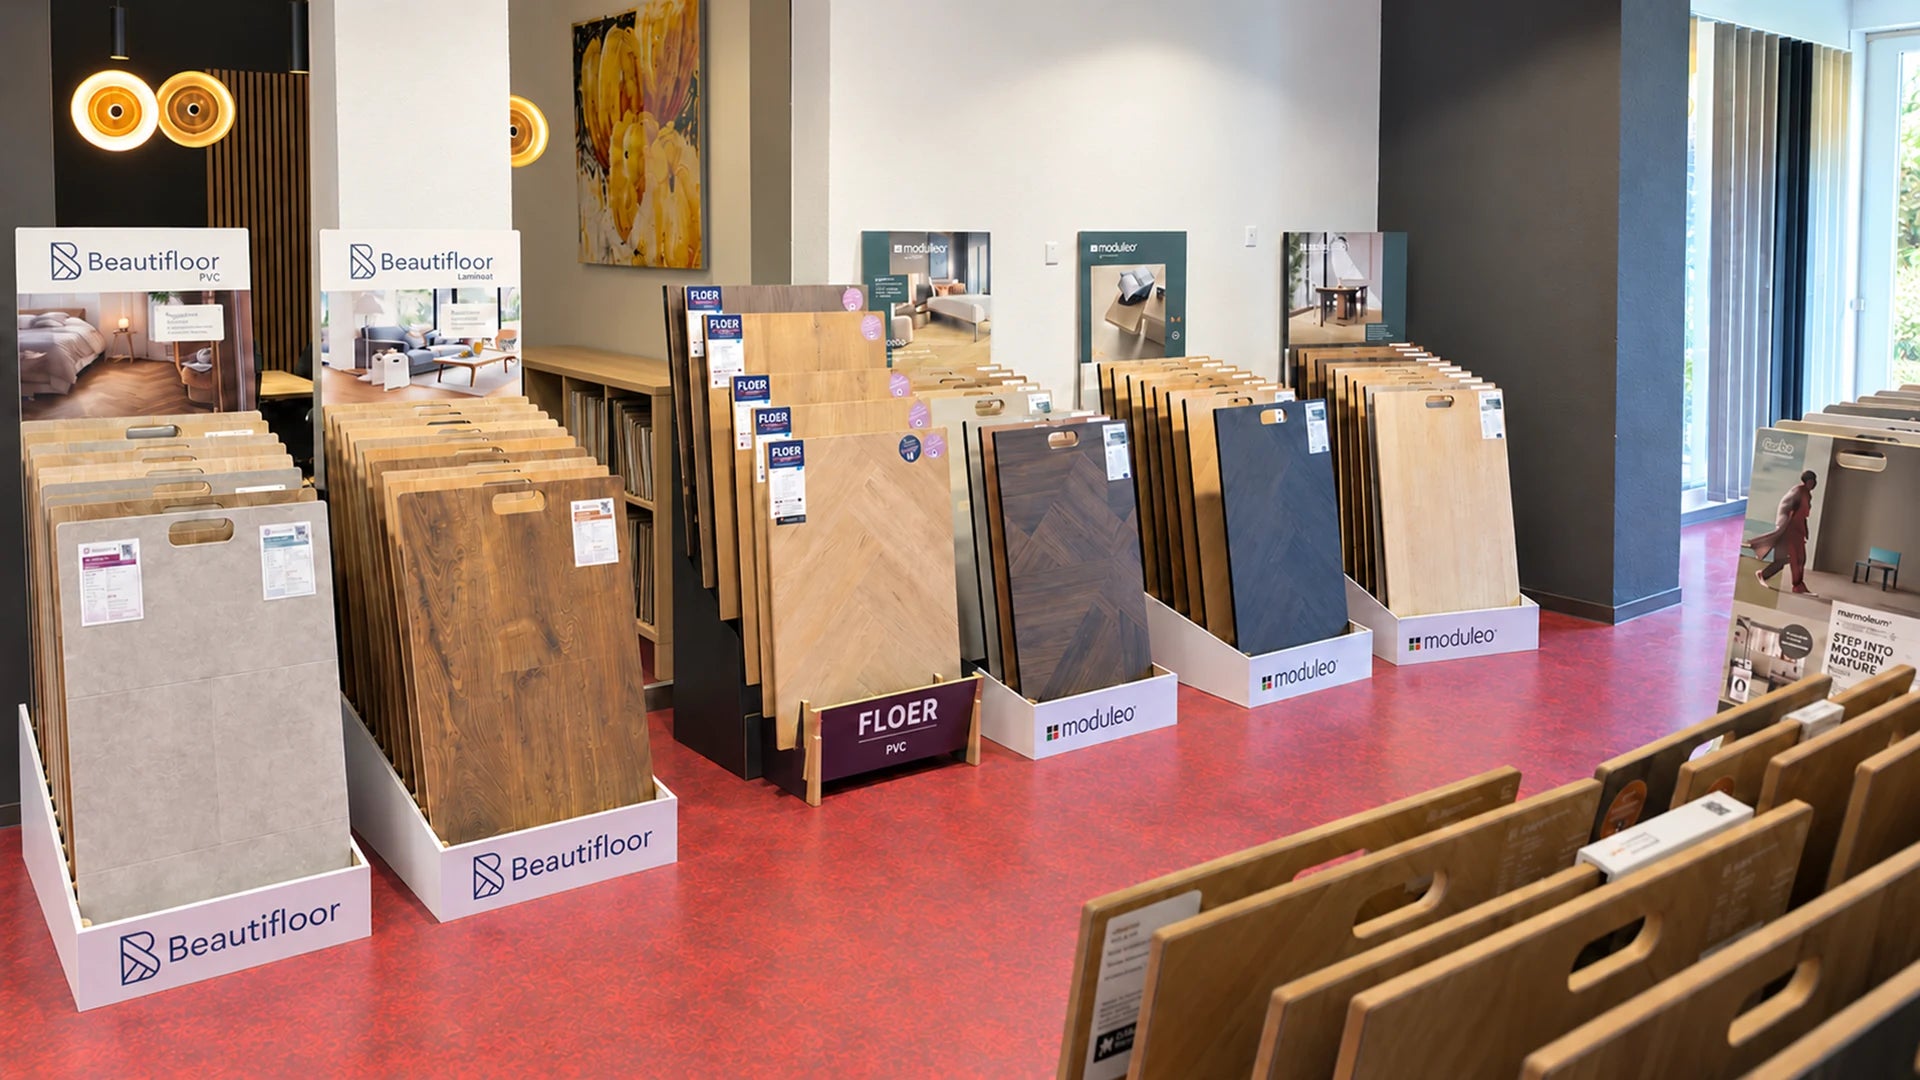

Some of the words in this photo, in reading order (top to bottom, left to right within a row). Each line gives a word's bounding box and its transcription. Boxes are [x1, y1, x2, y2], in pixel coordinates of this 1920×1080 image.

[88, 250, 220, 271] Beautifloor
[381, 251, 494, 271] Beautifloor
[199, 273, 221, 282] PVC
[690, 290, 720, 300] FLOER
[710, 319, 740, 329] FLOER
[737, 379, 768, 391] FLOER
[758, 412, 788, 424] FLOER
[772, 445, 802, 457] FLOER
[1837, 609, 1891, 627] marmoleum
[1424, 626, 1495, 650] moduleo
[1833, 632, 1862, 648] STEP
[1863, 641, 1894, 657] INTO
[1829, 654, 1878, 676] NATURE
[1831, 643, 1885, 666] MODERN
[1274, 658, 1337, 688] moduleo
[858, 698, 938, 736] FLOER
[1062, 705, 1135, 738] moduleo
[886, 741, 907, 755] PVC
[512, 830, 653, 881] Beautifloor
[168, 902, 341, 963] Beautifloor
